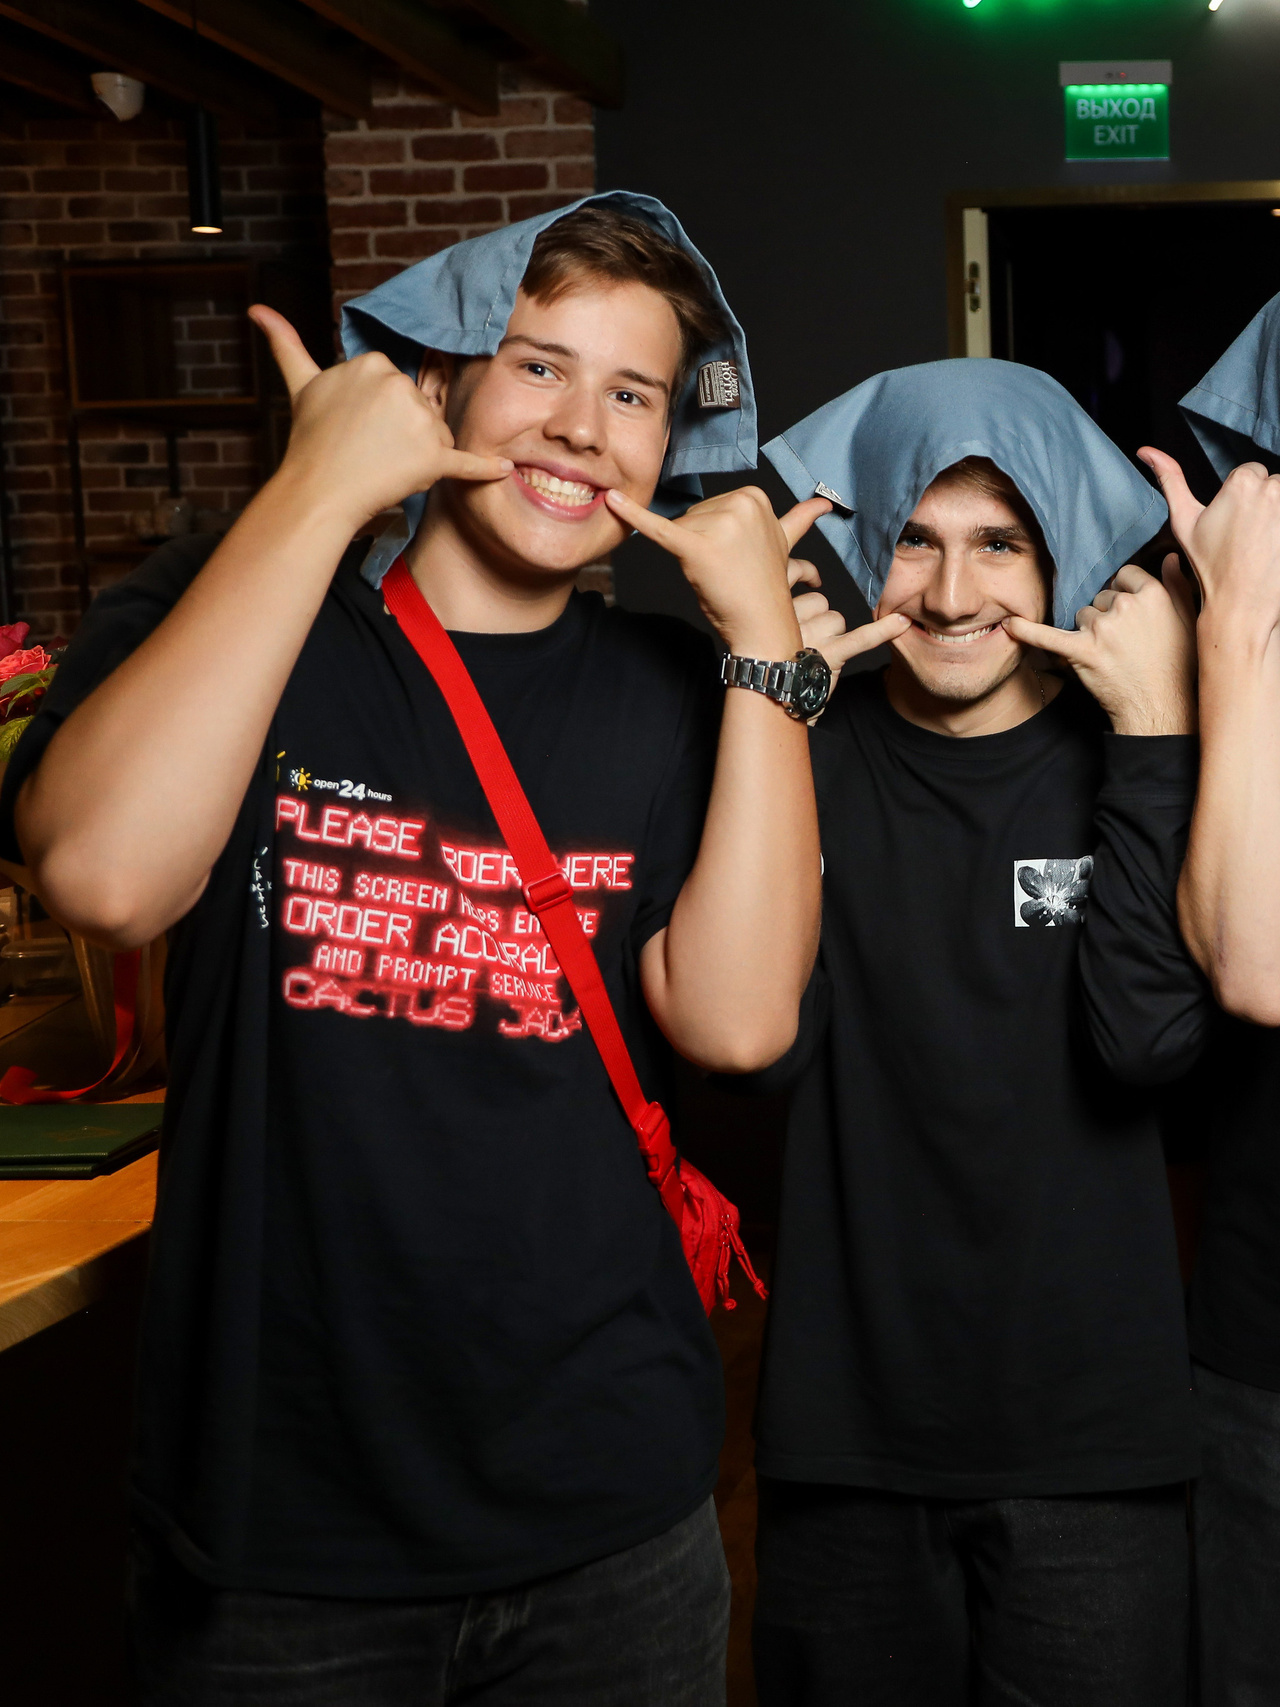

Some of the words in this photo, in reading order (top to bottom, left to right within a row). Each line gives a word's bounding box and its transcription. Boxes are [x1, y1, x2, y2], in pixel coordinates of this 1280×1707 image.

[1077, 97, 1156, 122] ВЫХОД
[1094, 125, 1139, 145] EXIT
[721, 361, 734, 402] HOTEL
[314, 778, 340, 791] open
[339, 779, 366, 801] 24
[367, 789, 393, 802] hours
[276, 798, 423, 857] PLEASE
[285, 860, 340, 892] THIS
[355, 873, 449, 911] SCREEN
[286, 896, 413, 948] ORDER
[284, 971, 472, 1027] CACTUS
[315, 945, 363, 973] AND
[378, 955, 477, 991] PROMPT
[492, 972, 559, 1003] SERVICE
